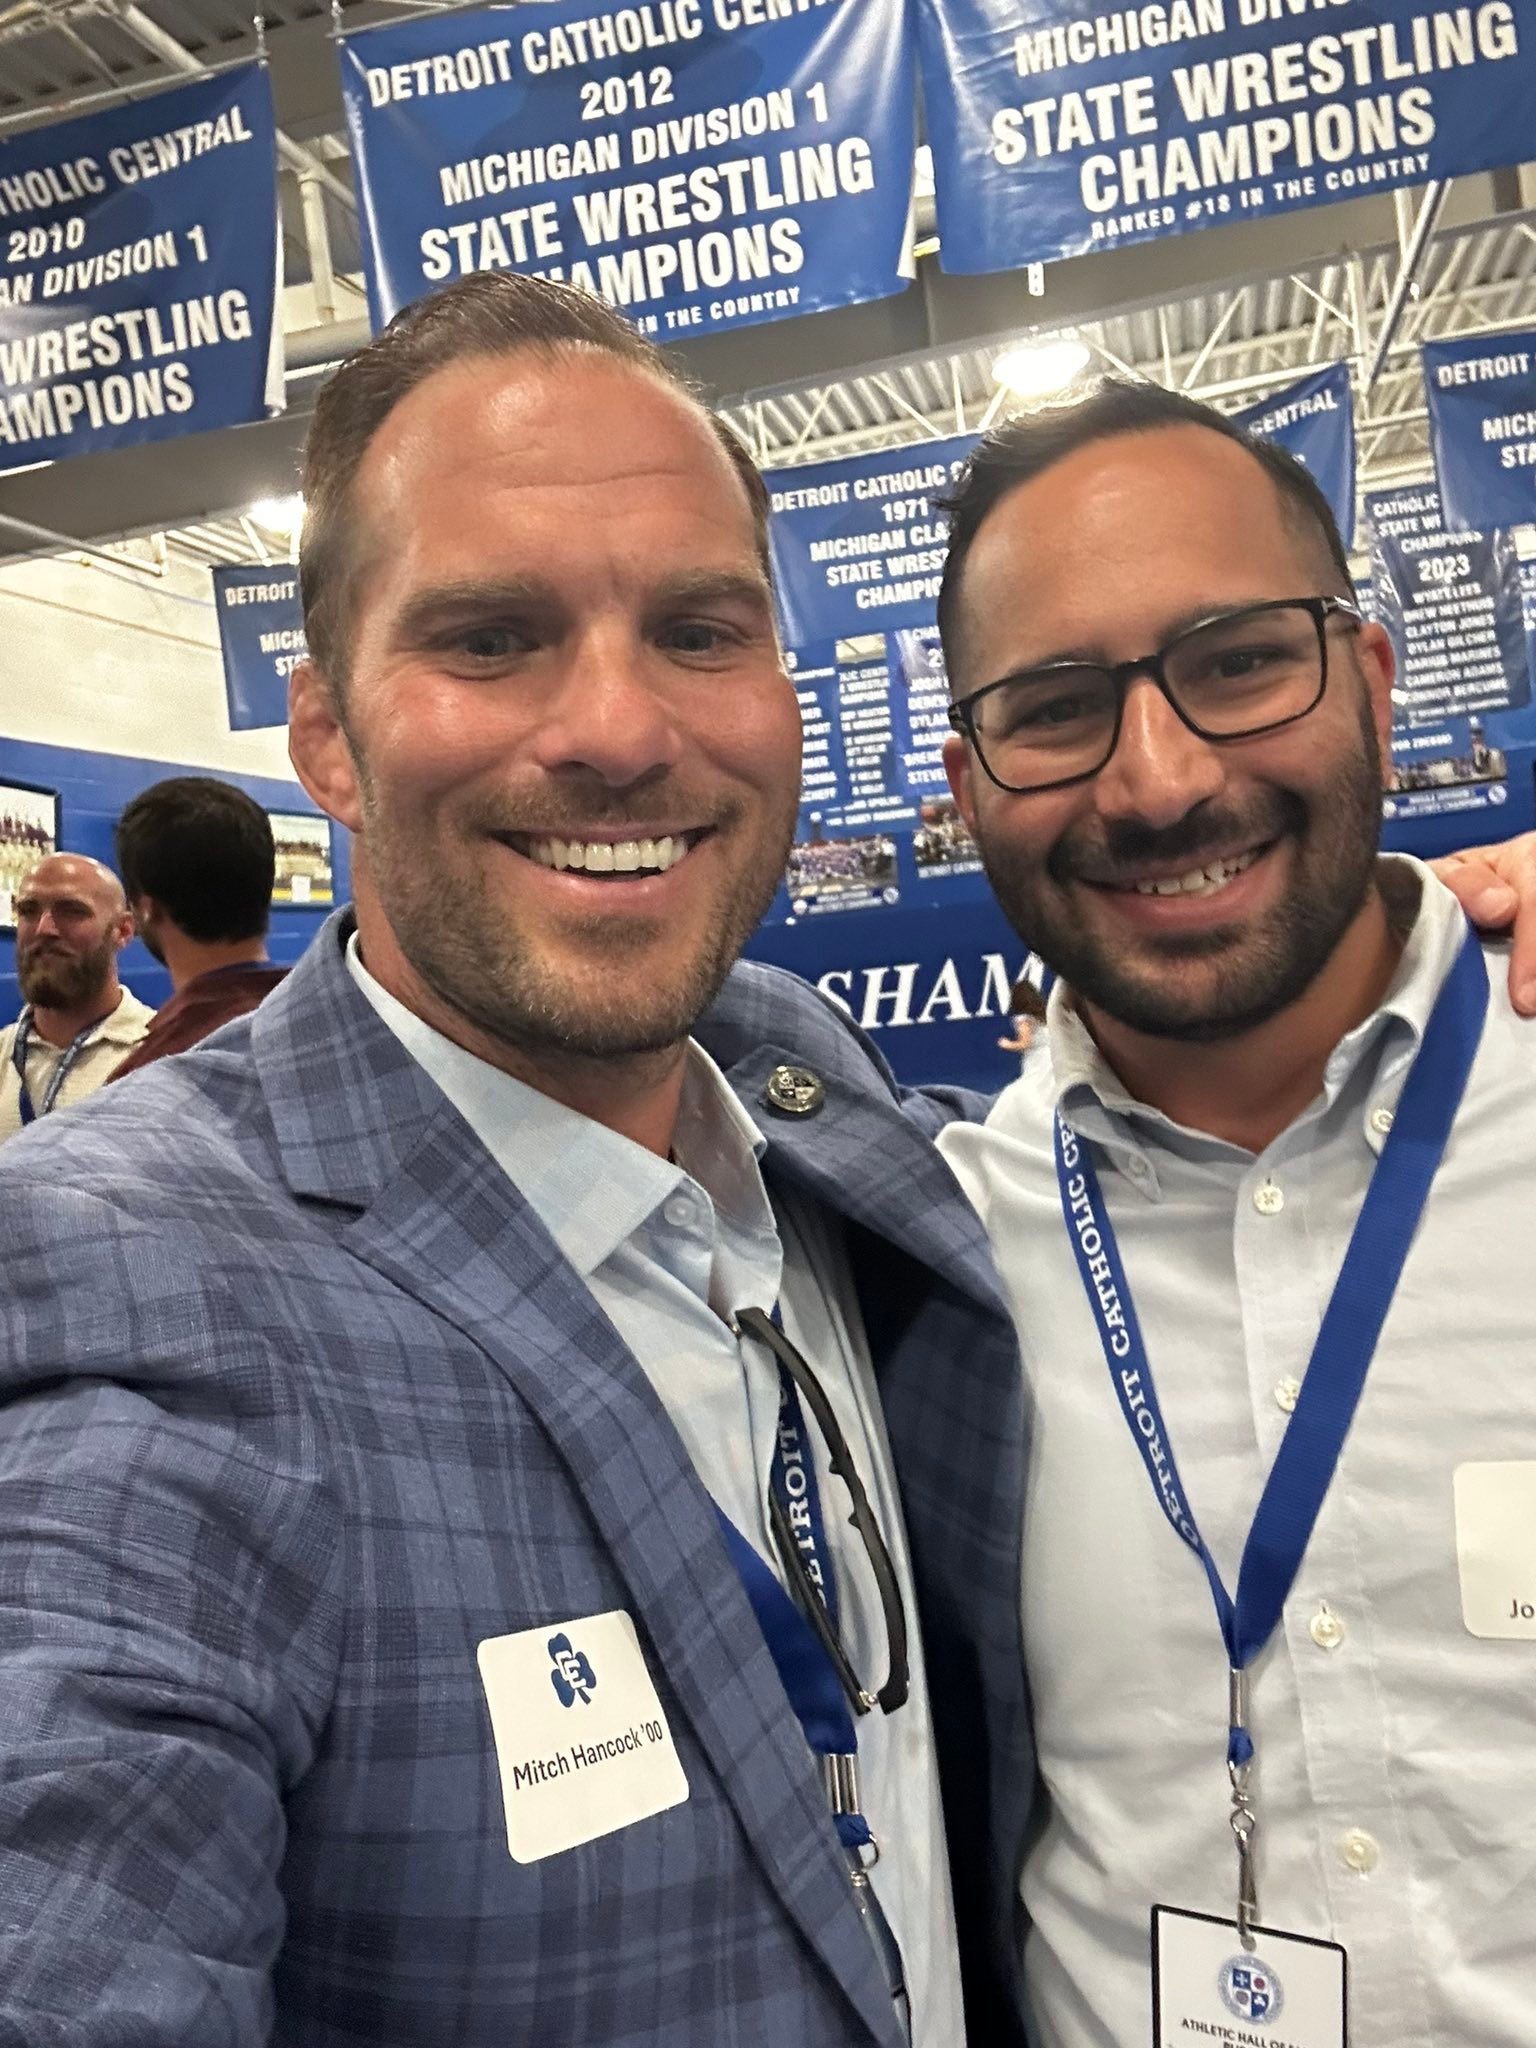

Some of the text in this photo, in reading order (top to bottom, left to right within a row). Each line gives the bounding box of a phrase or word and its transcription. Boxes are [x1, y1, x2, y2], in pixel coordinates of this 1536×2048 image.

[367, 0, 834, 107] DETROIT CATHOLIC CEN
[1015, 0, 1226, 77] MICHIGAN
[580, 66, 674, 120] 2012
[991, 2, 1518, 165] STATE WRESTLING
[110, 105, 252, 184] CENTRAL
[440, 82, 829, 206] MICHIGAN DIVISION 1
[1080, 88, 1436, 213] CHAMPIONS
[421, 136, 874, 281] STATE WRESTLING
[1092, 153, 1430, 240] RANKED #18 IN THE COUNTRY
[7, 217, 86, 263] 2010
[42, 233, 178, 298] DIVISION
[186, 225, 208, 261] 1
[665, 305, 702, 329] THE
[710, 287, 800, 320] COUNTRY
[0, 290, 253, 386] WRESTLING
[1437, 353, 1529, 388] DETROIT
[771, 482, 849, 513] DETROIT
[854, 464, 946, 500] CATHOLIC
[881, 497, 929, 522] 1971
[1372, 493, 1439, 517] CATHOLIC
[810, 528, 906, 562] MICHIGAN
[1379, 518, 1419, 537] STATE
[1401, 532, 1483, 554] CHAMPIONS
[225, 581, 296, 606] DETROIT
[826, 559, 883, 586] STATE
[1418, 553, 1470, 581] 2023
[1068, 1174, 1130, 1357] CATHOLIC
[1121, 1369, 1200, 1547] DETROIT
[779, 1420, 827, 1608] ETROIT
[1510, 1599, 1535, 1619] Jo
[513, 1720, 663, 1790] Mitch Hancock '00
[1182, 2018, 1235, 2041] ATHLETIC
[1238, 2030, 1267, 2048] HALL
